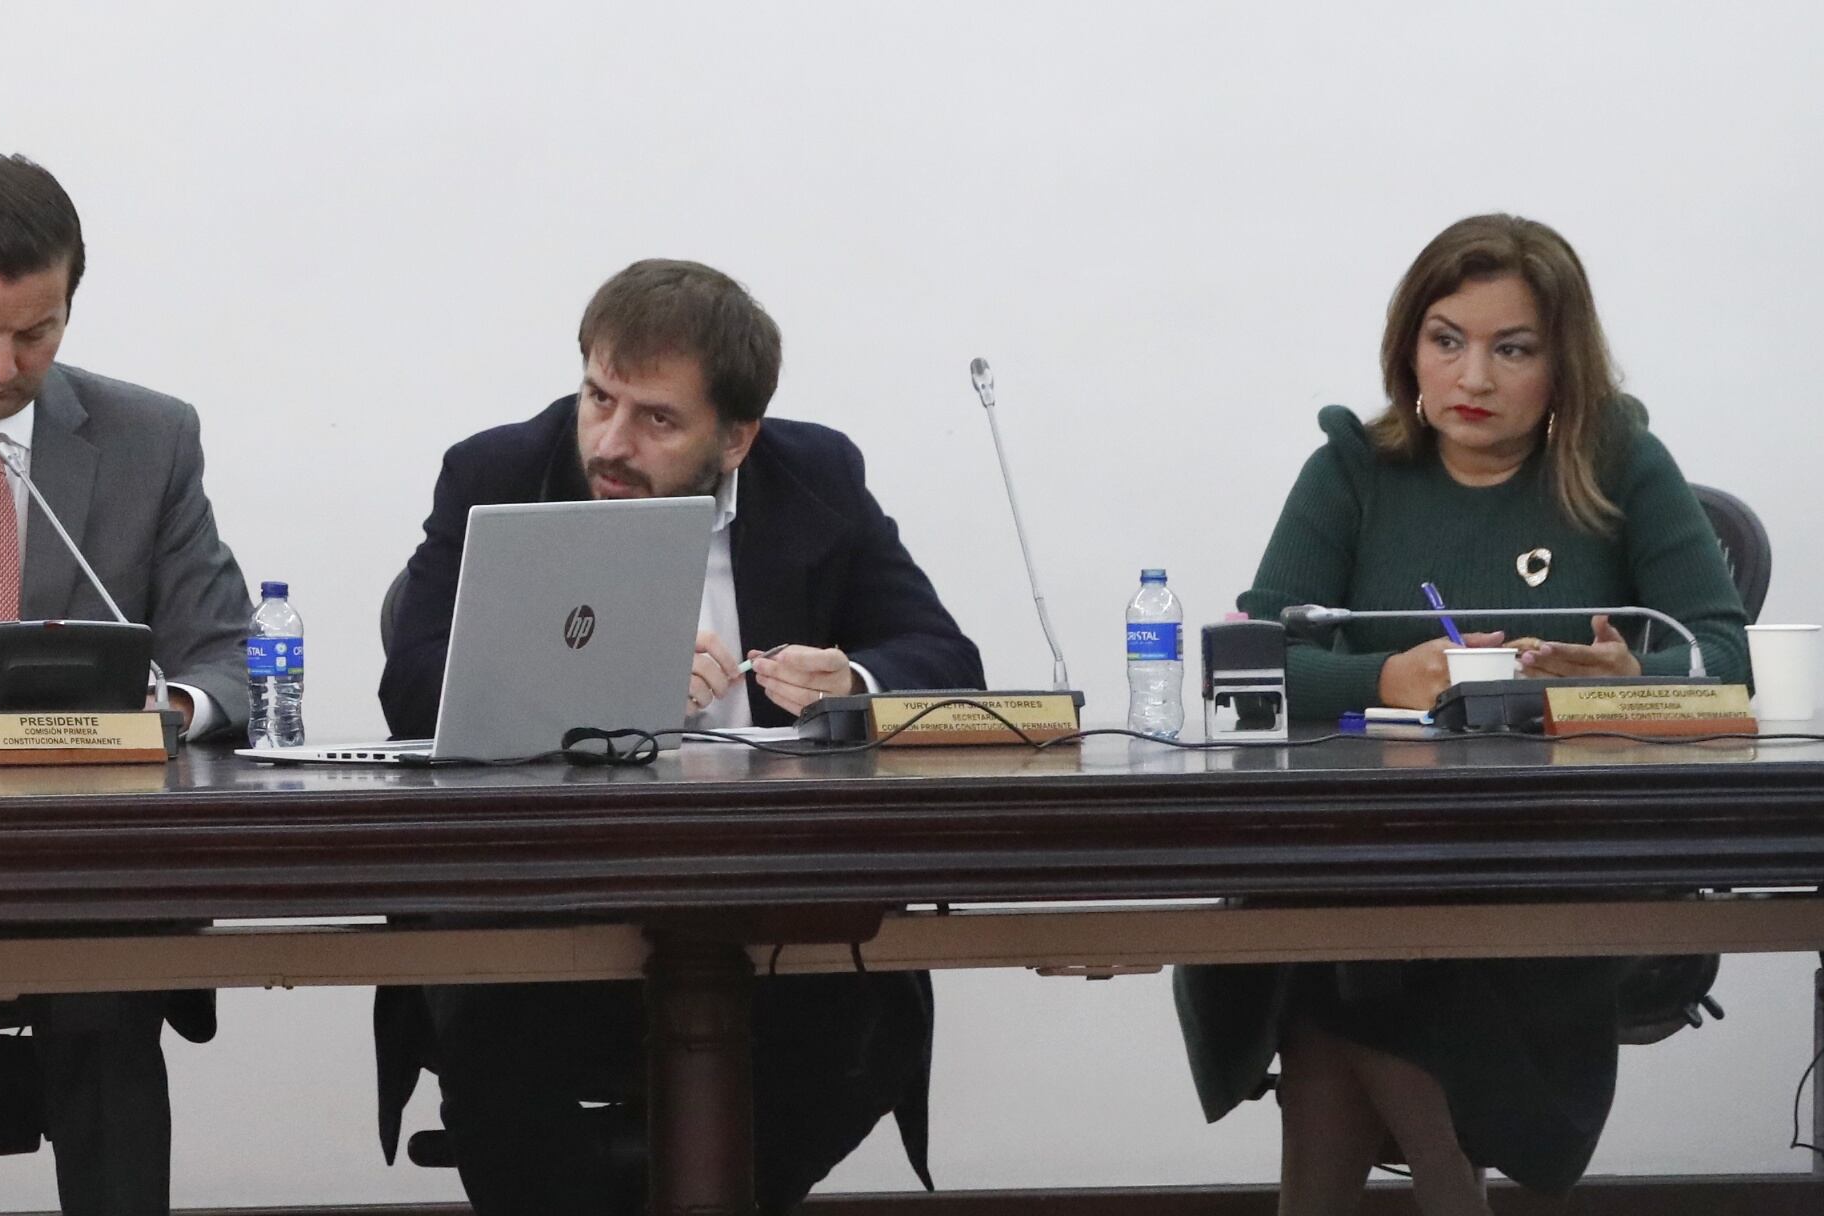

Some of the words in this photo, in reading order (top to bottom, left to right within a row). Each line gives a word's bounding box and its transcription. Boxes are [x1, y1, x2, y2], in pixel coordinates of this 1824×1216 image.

[565, 604, 595, 650] hp
[1672, 689, 1717, 698] QUIROGA
[903, 701, 928, 710] YURY
[968, 700, 1003, 710] SRRA
[1005, 700, 1043, 709] TORRES
[19, 716, 99, 726] PRESIDENTE
[952, 713, 999, 722] SECRETARI
[24, 727, 62, 735] COMISIÓN
[881, 723, 919, 732] COMN
[920, 723, 954, 731] PRIMERA
[955, 722, 1019, 731] CONSTITUCIOL
[1022, 721, 1073, 730] PERMANENTE
[3, 737, 69, 745] CONSTITUCIONAL
[70, 737, 122, 745] PERMANENTE
